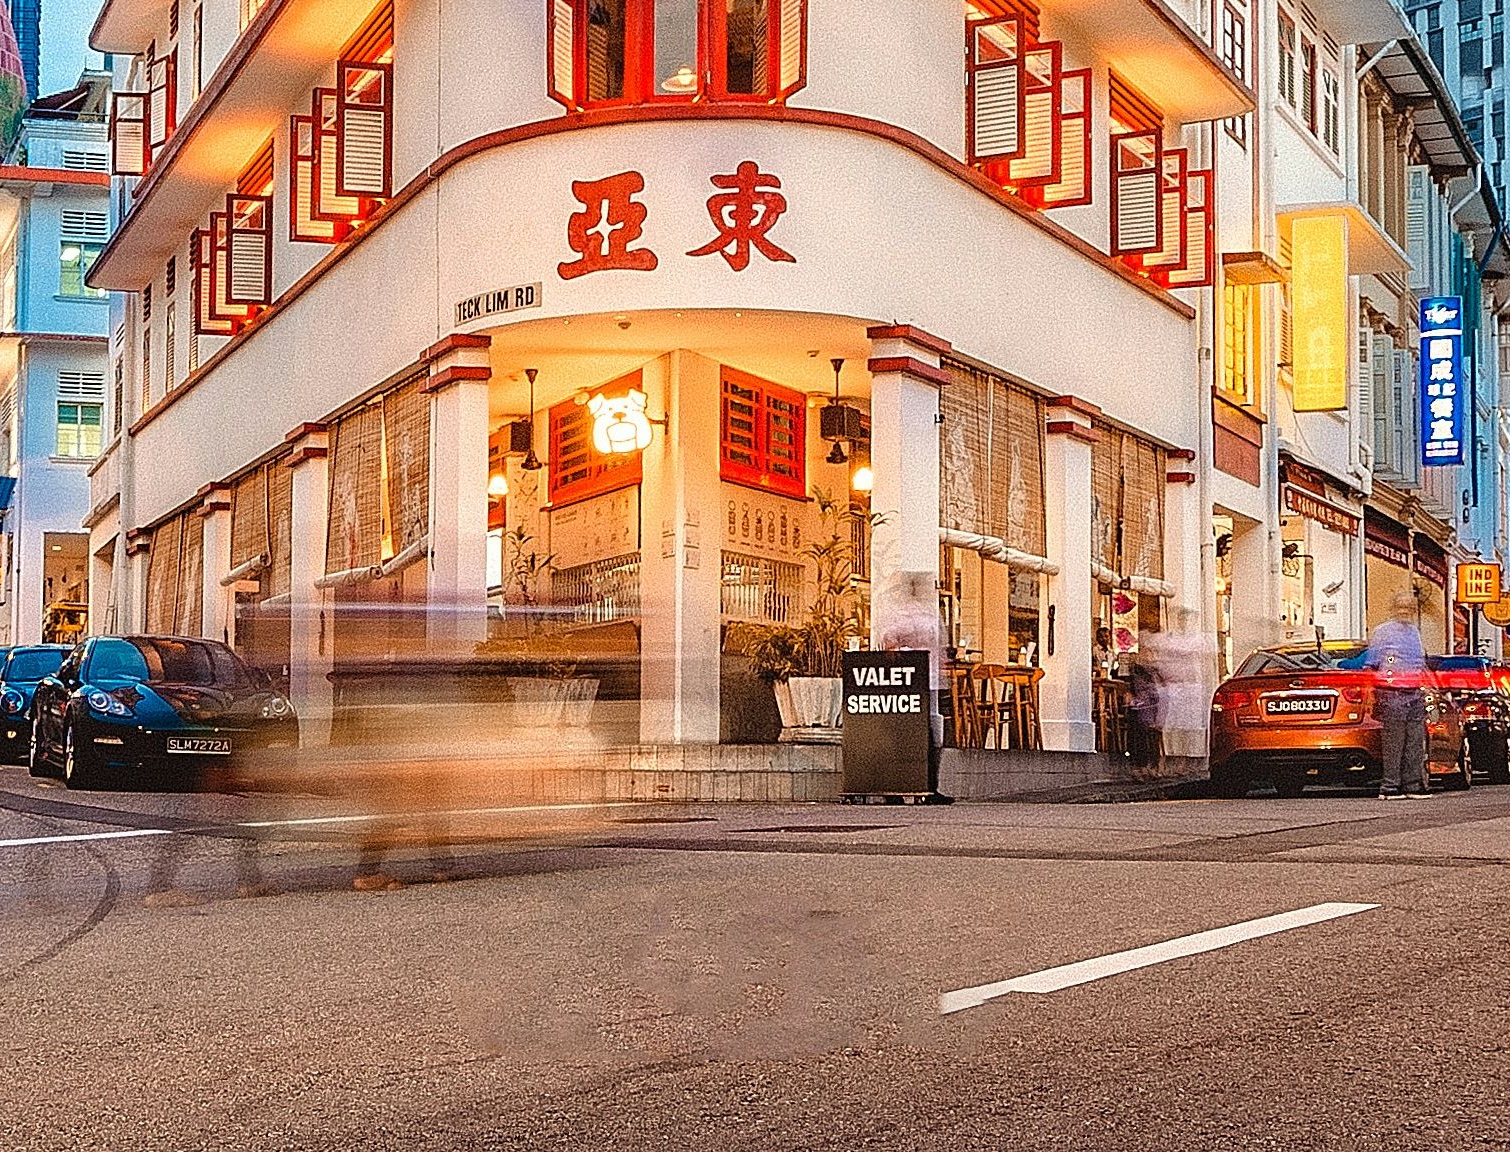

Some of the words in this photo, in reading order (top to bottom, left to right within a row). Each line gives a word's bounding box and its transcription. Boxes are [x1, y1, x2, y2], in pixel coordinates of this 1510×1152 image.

[457, 296, 481, 322] TECK
[485, 289, 509, 314] LIM
[515, 285, 534, 308] RD
[1469, 569, 1492, 580] IND
[852, 666, 916, 686] VALET
[847, 694, 921, 714] SERVICE
[169, 739, 229, 751] SLM7272A
